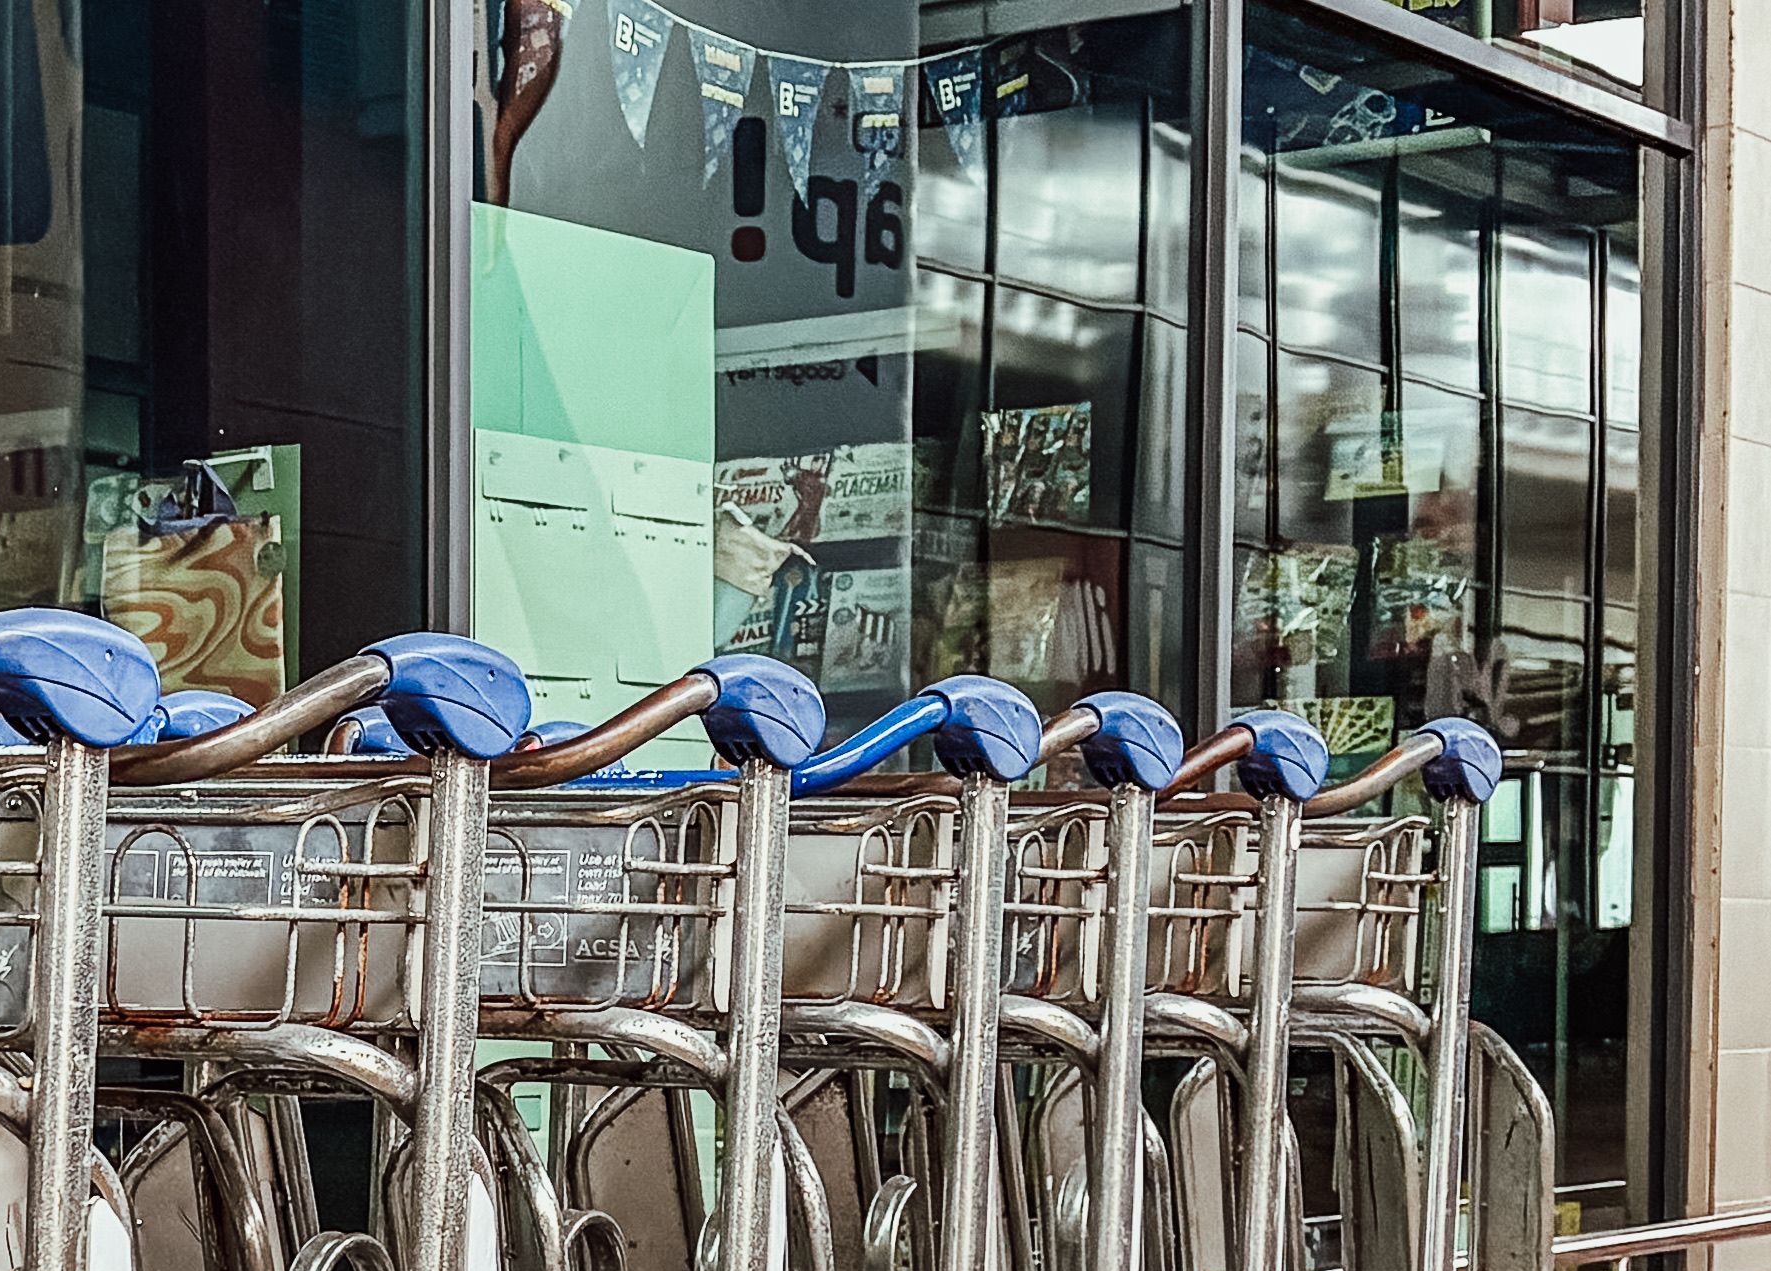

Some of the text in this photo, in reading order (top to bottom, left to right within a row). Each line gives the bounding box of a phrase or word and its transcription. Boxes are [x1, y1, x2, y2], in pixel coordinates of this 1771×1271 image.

[579, 853, 602, 866] Use
[578, 867, 603, 879] own
[577, 880, 608, 892] Load
[575, 938, 641, 959] ACSA
